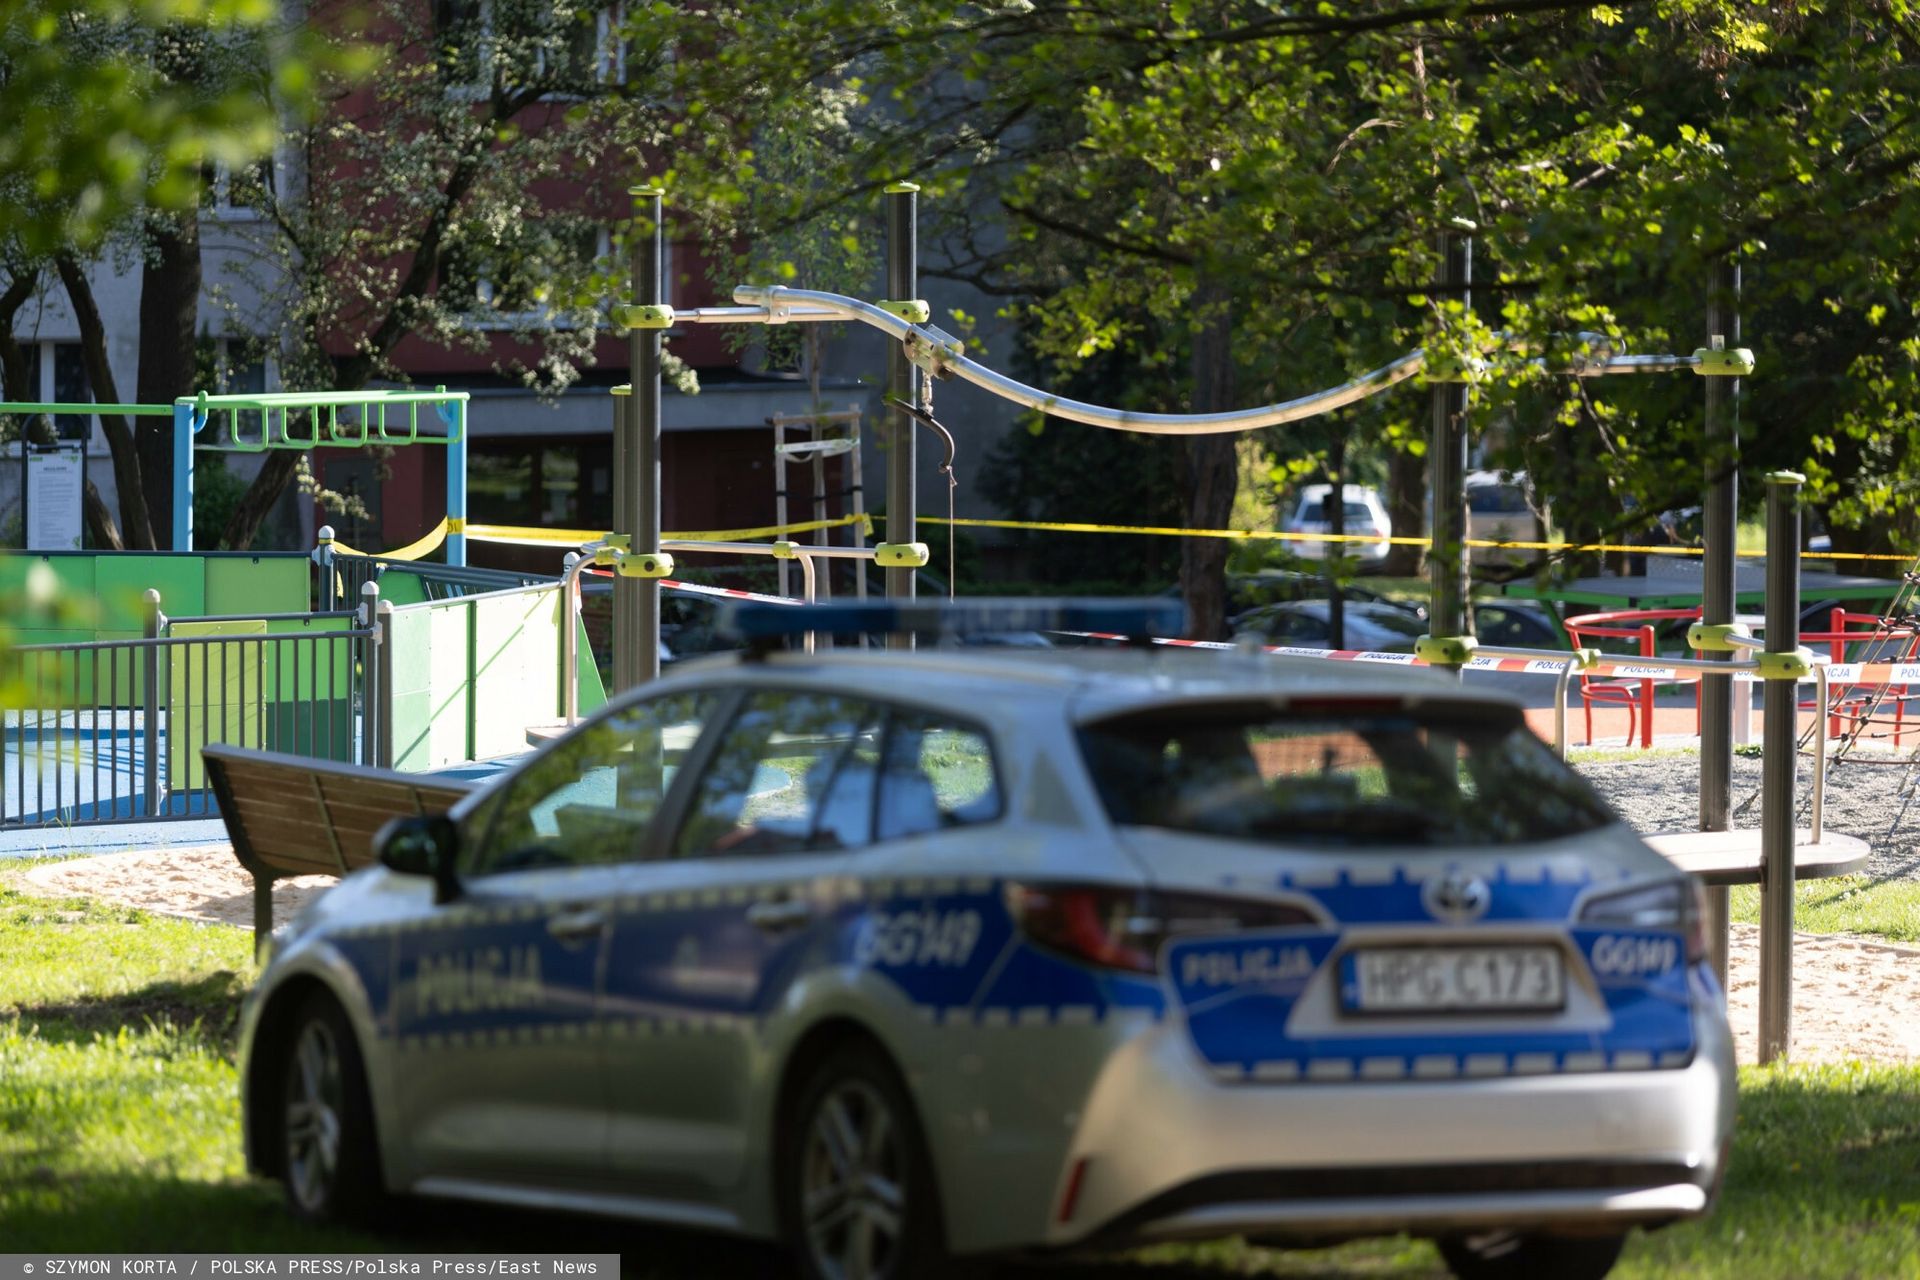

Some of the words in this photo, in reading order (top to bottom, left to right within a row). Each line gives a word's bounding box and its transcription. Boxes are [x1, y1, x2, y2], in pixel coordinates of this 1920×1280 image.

[1535, 660, 1568, 670] POLIC
[1182, 945, 1314, 987] POLICJA
[1369, 951, 1445, 999] HPG
[1454, 951, 1553, 1000] C173
